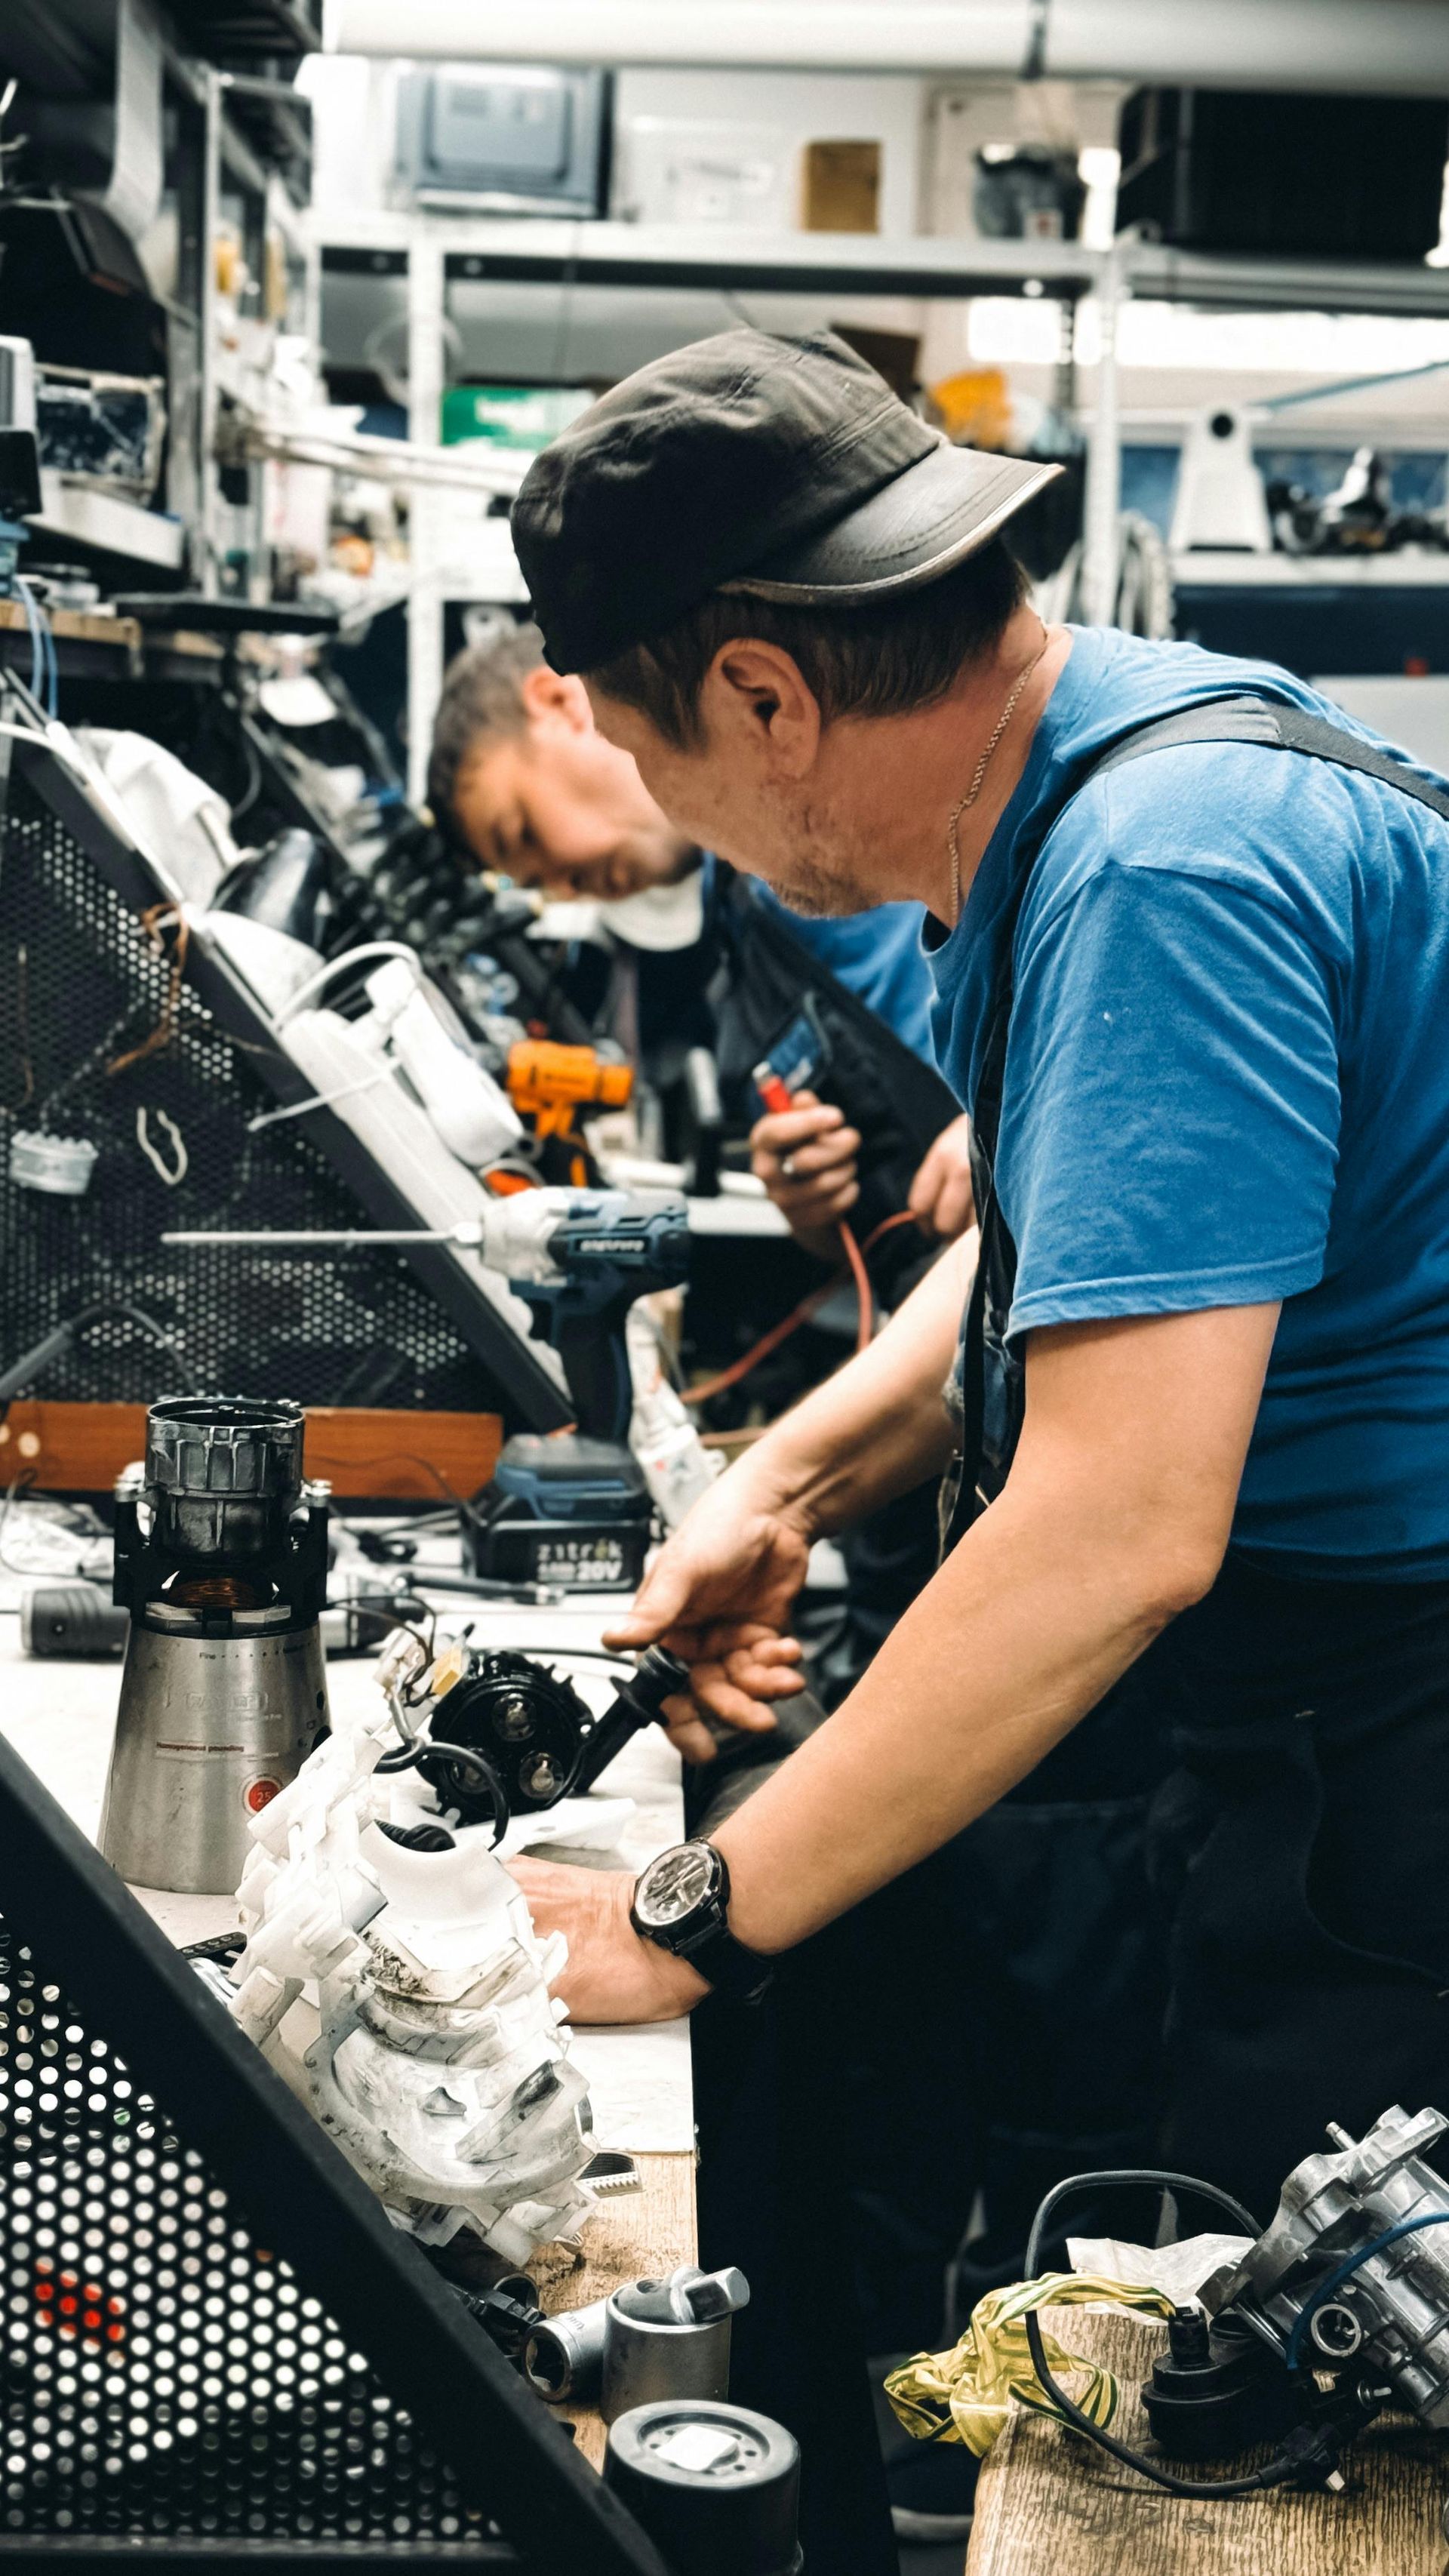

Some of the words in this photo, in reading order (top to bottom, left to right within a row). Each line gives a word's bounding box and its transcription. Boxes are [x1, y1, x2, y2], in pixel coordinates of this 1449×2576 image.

[577, 1560, 623, 1581] 20V
[208, 1744, 245, 1753] pounding
[257, 1791, 272, 1803] 25
